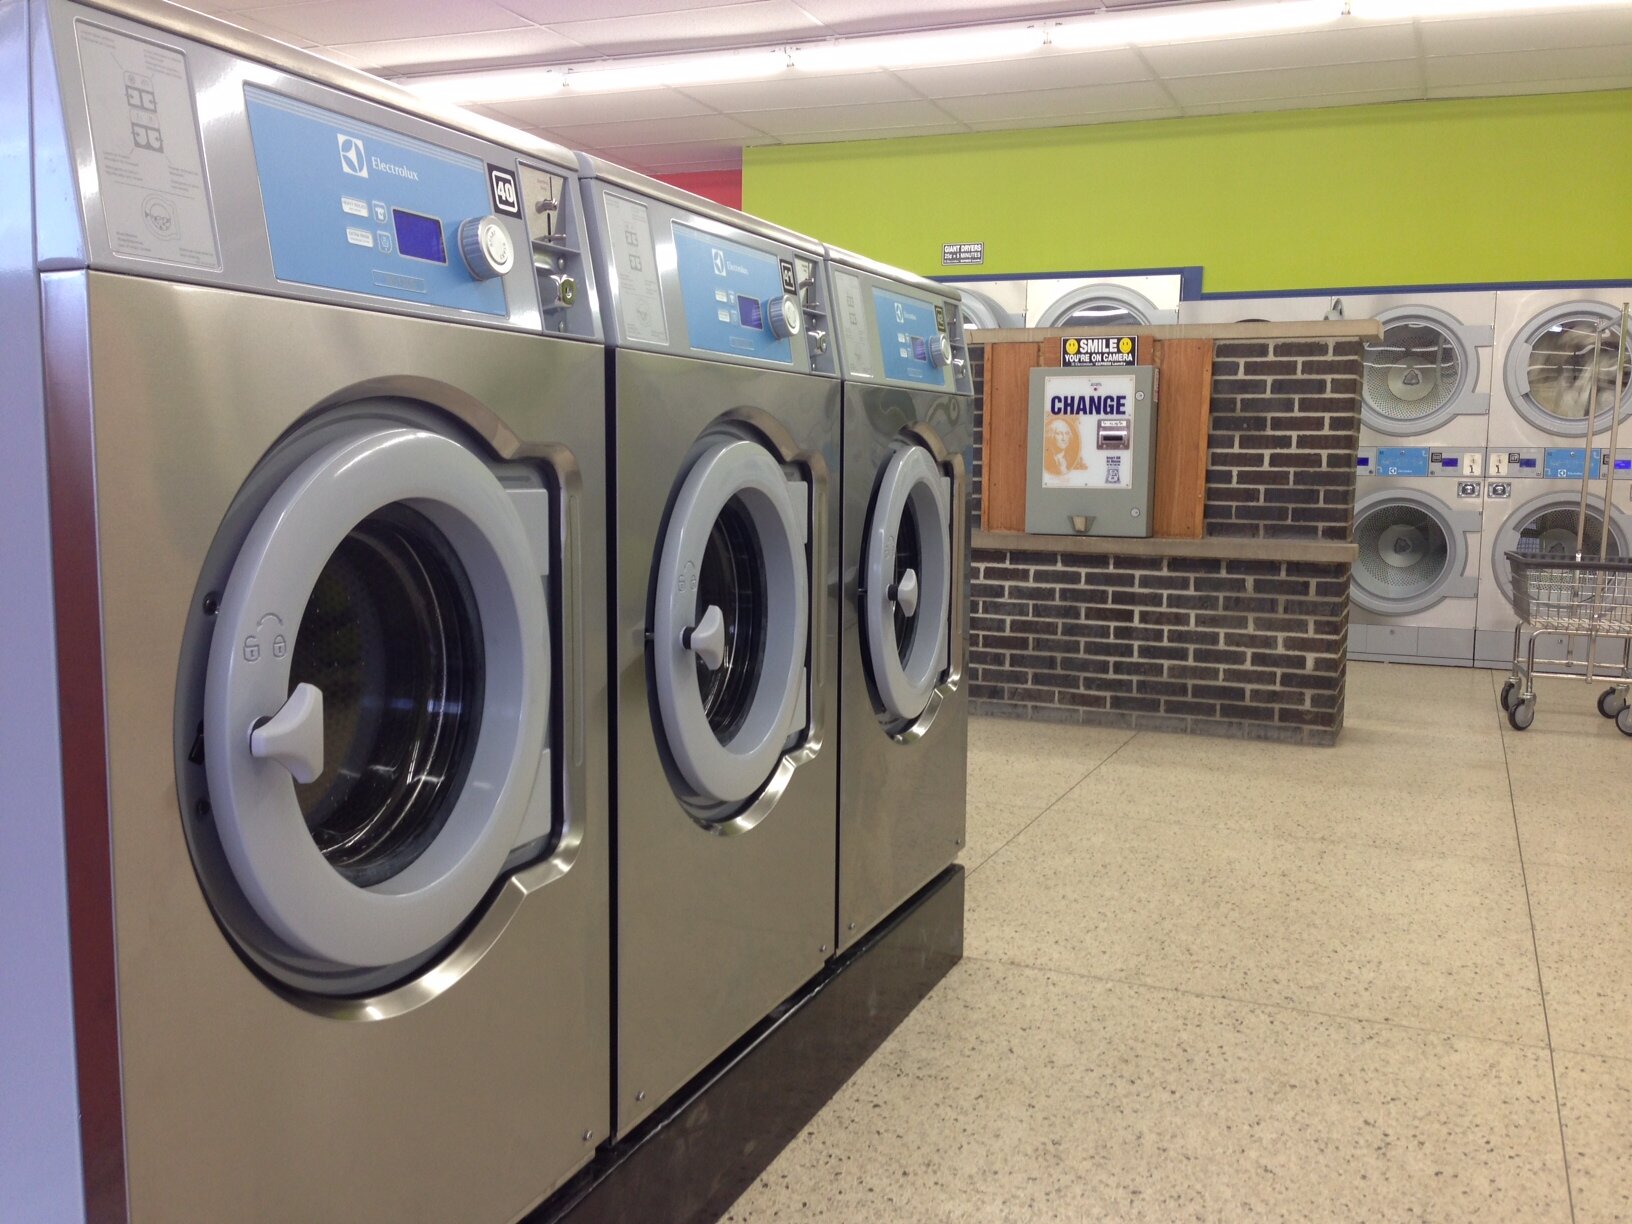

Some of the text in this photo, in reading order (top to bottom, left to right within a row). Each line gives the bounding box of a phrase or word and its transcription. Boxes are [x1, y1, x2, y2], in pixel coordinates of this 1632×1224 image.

[371, 156, 419, 181] Electrolux
[497, 181, 514, 202] 40
[961, 244, 981, 252] DRYERS
[1080, 339, 1118, 353] SMILE
[1064, 353, 1133, 362] YOU'RE ON CAMERA
[1051, 396, 1126, 415] CHANGE
